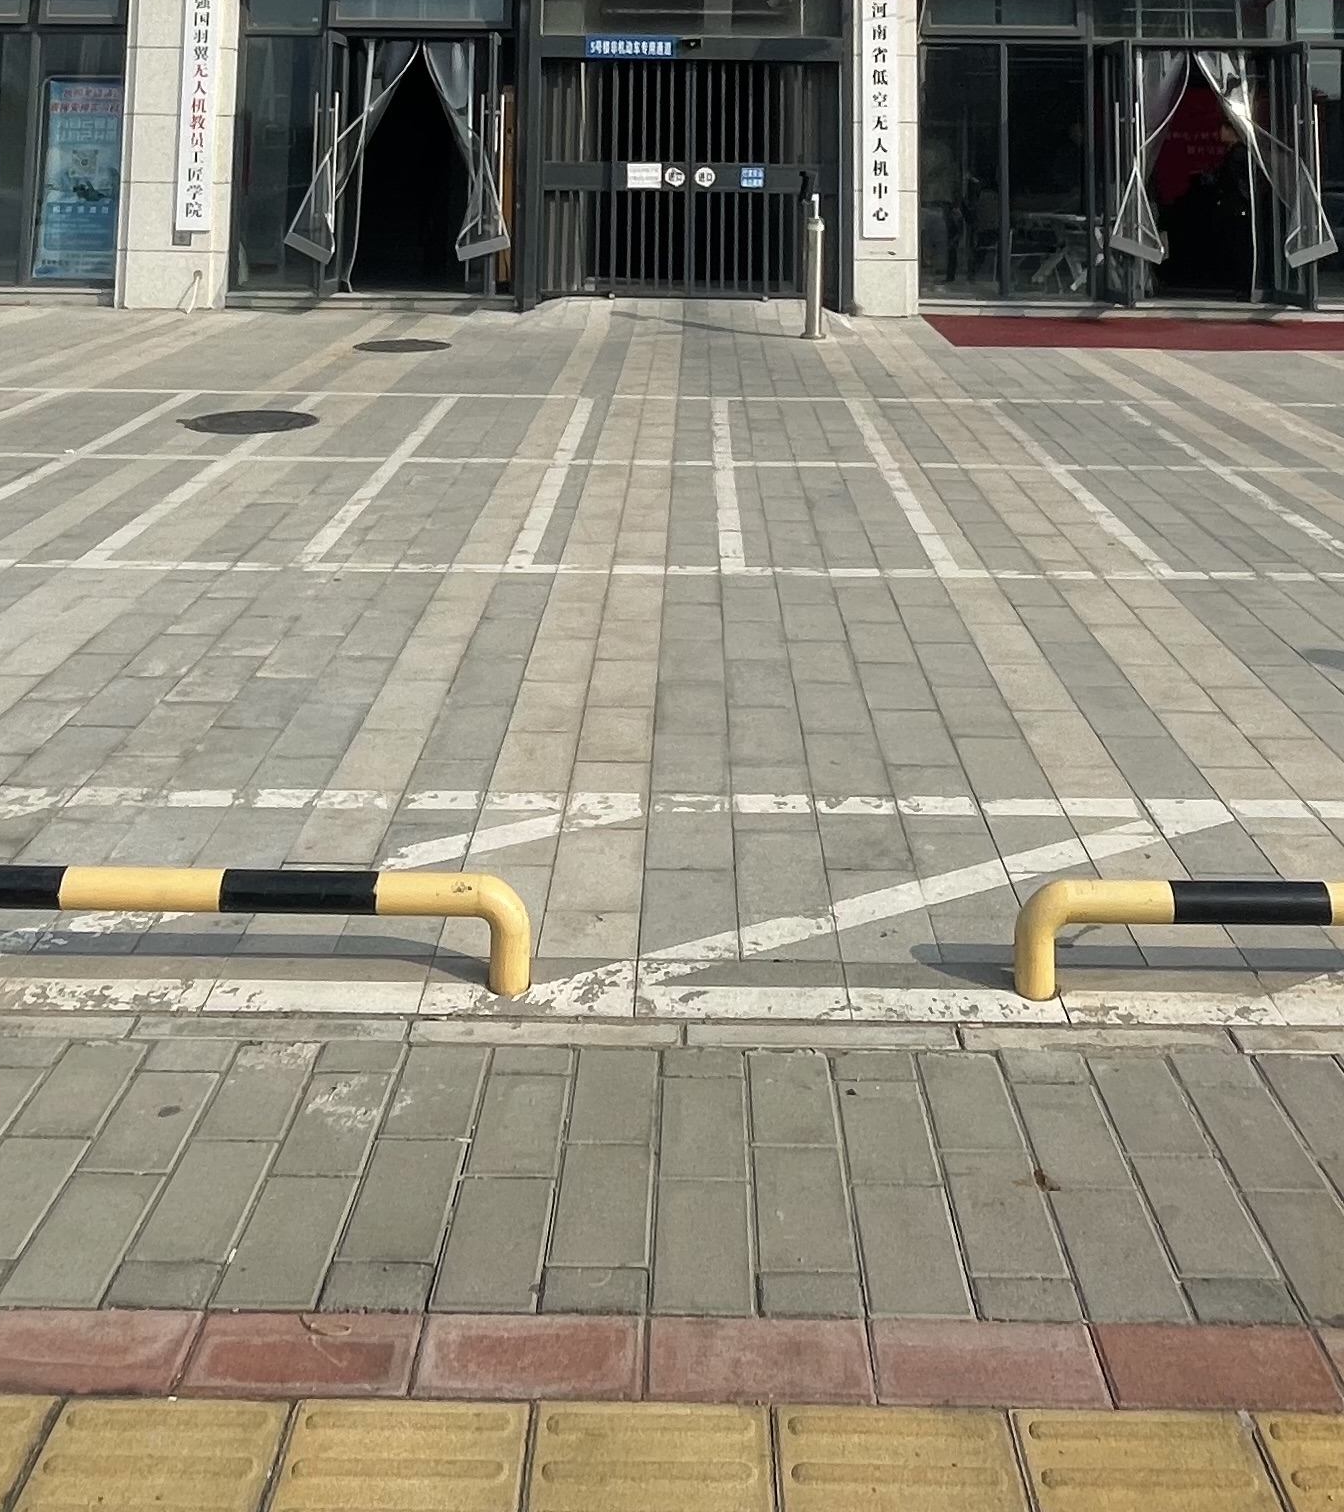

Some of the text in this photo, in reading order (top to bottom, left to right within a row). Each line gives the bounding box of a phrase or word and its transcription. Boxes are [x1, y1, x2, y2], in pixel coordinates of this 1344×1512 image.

[871, 0, 889, 222] 河南省低空无人机中心
